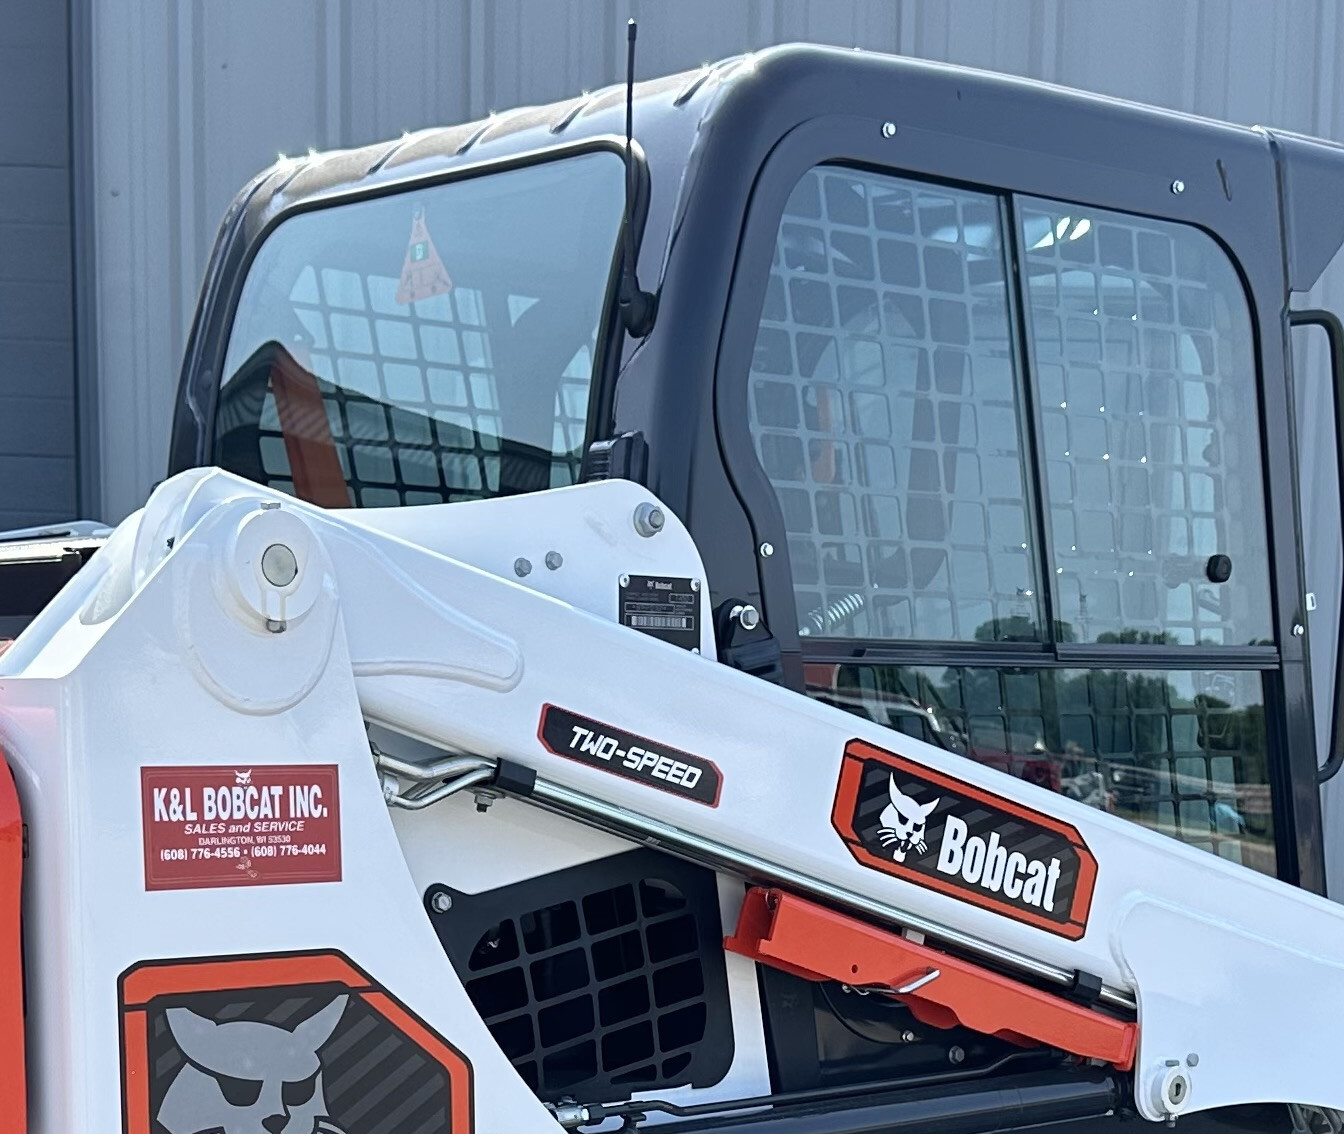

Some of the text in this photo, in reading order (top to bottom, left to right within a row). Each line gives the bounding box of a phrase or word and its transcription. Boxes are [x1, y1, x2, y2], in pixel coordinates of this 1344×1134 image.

[569, 725, 703, 789] TWO-SPEED
[153, 784, 328, 822] K&L BOBCAT INC.
[184, 820, 305, 835] SALES and SERVICE
[160, 844, 326, 861] (608) 776-4556 (608) 776-4044
[936, 814, 1061, 912] Bobcat
